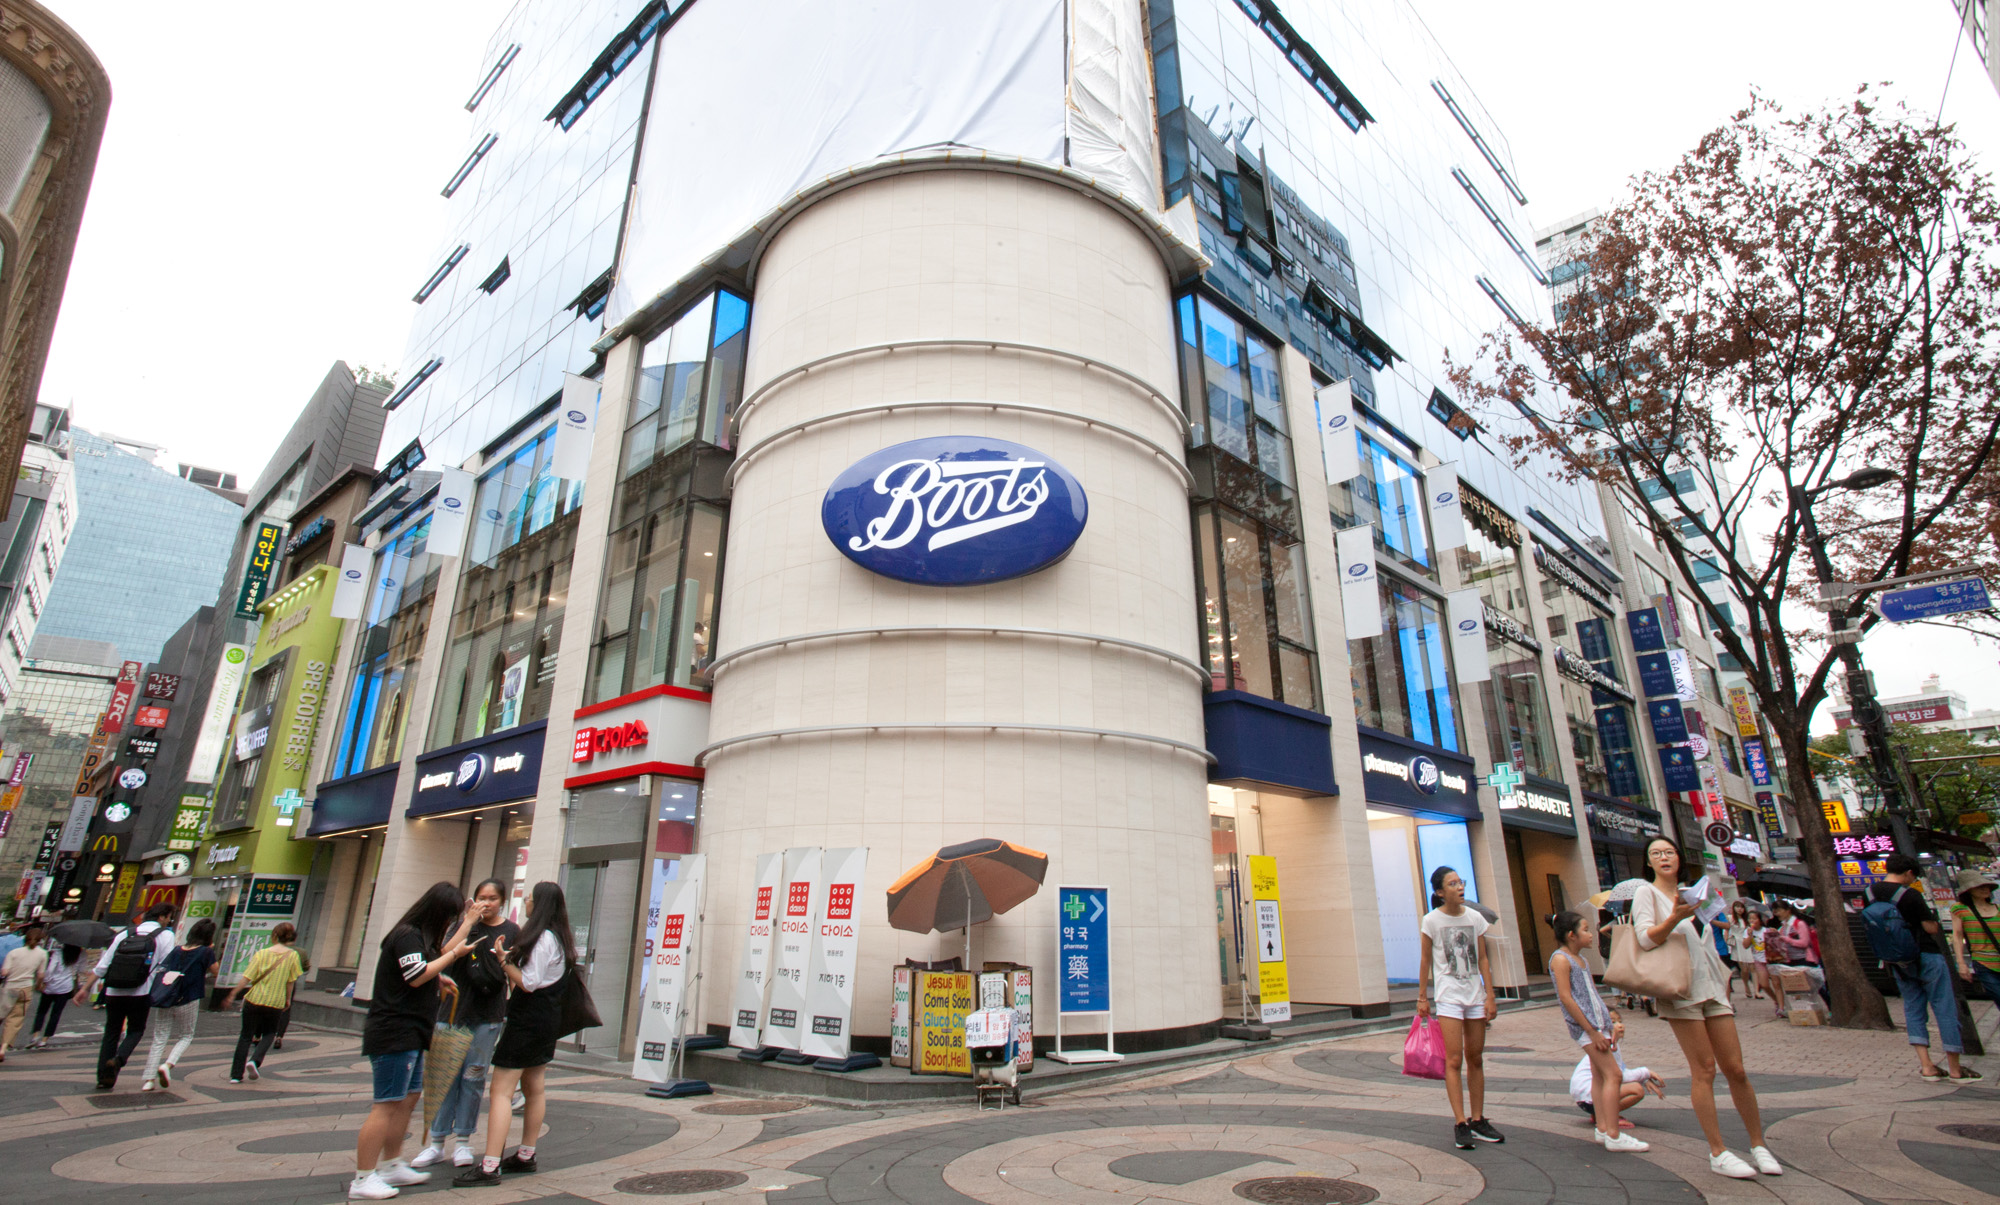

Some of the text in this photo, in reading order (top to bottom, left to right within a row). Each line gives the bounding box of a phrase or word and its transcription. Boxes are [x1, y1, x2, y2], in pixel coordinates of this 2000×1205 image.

[849, 457, 1049, 552] Boots
[253, 528, 278, 572] 티안나
[1936, 580, 1982, 597] 명동7길
[1903, 592, 1985, 611] Myeongdong 7-gil
[150, 673, 179, 686] 강남
[1670, 658, 1688, 696] GALAXY
[108, 690, 130, 724] KFC
[285, 660, 326, 756] SPE COFFEE
[130, 738, 158, 748] Korea
[594, 719, 648, 753] 다이소
[137, 746, 156, 754] Spa
[76, 754, 98, 795] DVD
[419, 770, 455, 792] pharmacy
[493, 752, 524, 773] beauty
[1364, 753, 1466, 794] pharmacy Boots beauty
[1528, 791, 1572, 818] BAGUETTE
[176, 809, 202, 830] 粥
[1834, 835, 1895, 855] 換錢
[256, 882, 286, 892] 티안나
[1933, 890, 1954, 900] SIM
[190, 905, 212, 917] 50
[756, 908, 768, 917] daiso
[789, 904, 806, 913] daiso
[830, 906, 850, 916] daiso
[750, 925, 770, 936] 다이소
[782, 921, 809, 934] 다이소
[822, 924, 853, 938] 다이소
[1063, 926, 1089, 941] 약국
[664, 937, 680, 946] daiso
[400, 954, 421, 966] CALI
[656, 954, 681, 966] 다이소
[1068, 954, 1090, 980] 藥
[745, 970, 762, 984] 지하 1층
[777, 968, 800, 982] 지하 1층
[818, 973, 846, 988] 지하 1층
[927, 974, 968, 990] Jesus Will
[894, 988, 909, 1002] Soon
[924, 992, 971, 1009] Come Soon
[1015, 992, 1031, 1006] Com
[650, 1000, 672, 1015] 지하 1층
[924, 1012, 967, 1028] Gluco Chi
[900, 1026, 908, 1038] as
[894, 1040, 908, 1057] Chip
